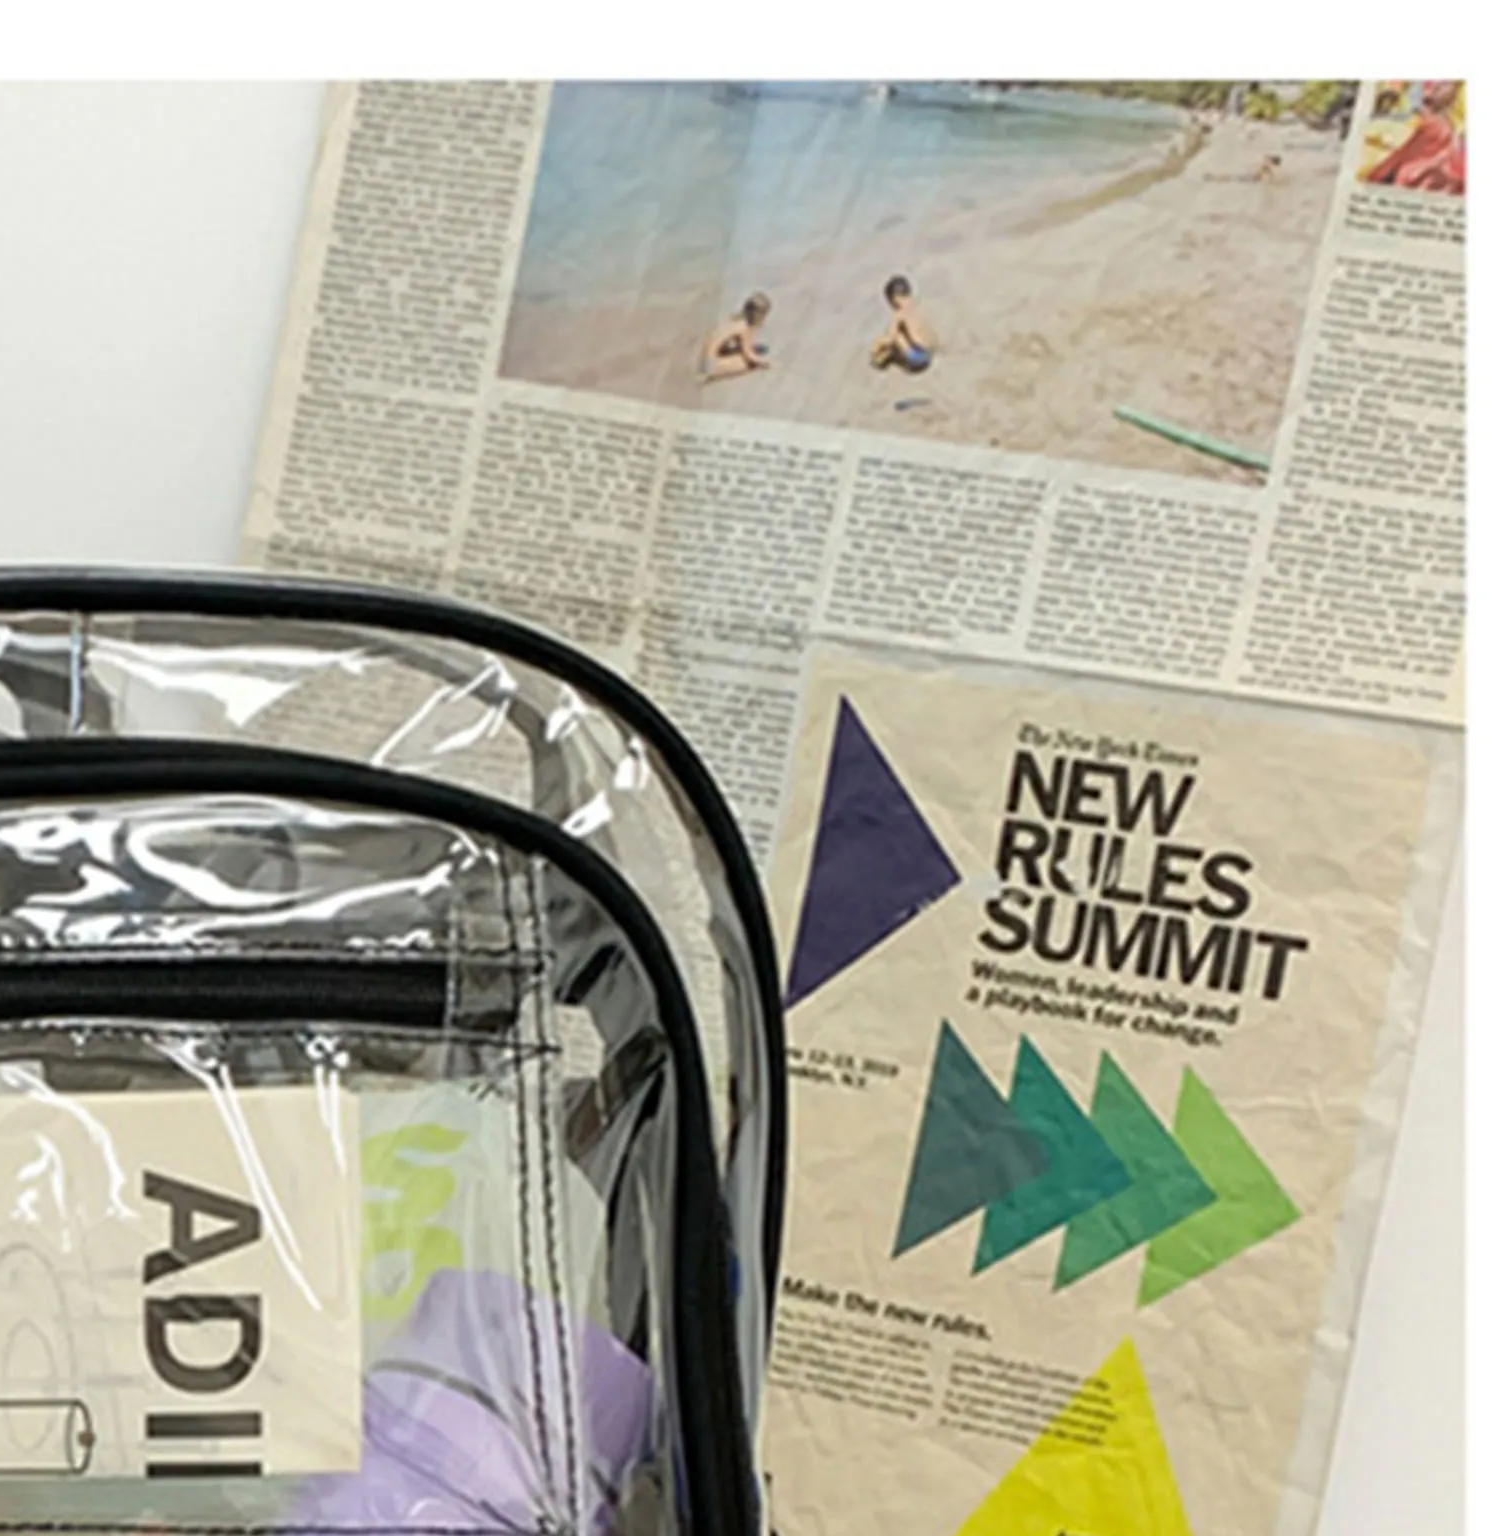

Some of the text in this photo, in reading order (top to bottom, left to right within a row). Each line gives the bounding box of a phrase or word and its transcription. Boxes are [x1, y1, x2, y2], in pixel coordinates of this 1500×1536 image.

[1007, 750, 1195, 837] NEW
[997, 819, 1253, 919] RULES
[978, 888, 1309, 1001] SUMMIT
[966, 986, 1222, 1047] a playbook for change.
[971, 960, 1240, 1026] Women, leadership and
[782, 1275, 993, 1342] Make the new rules.
